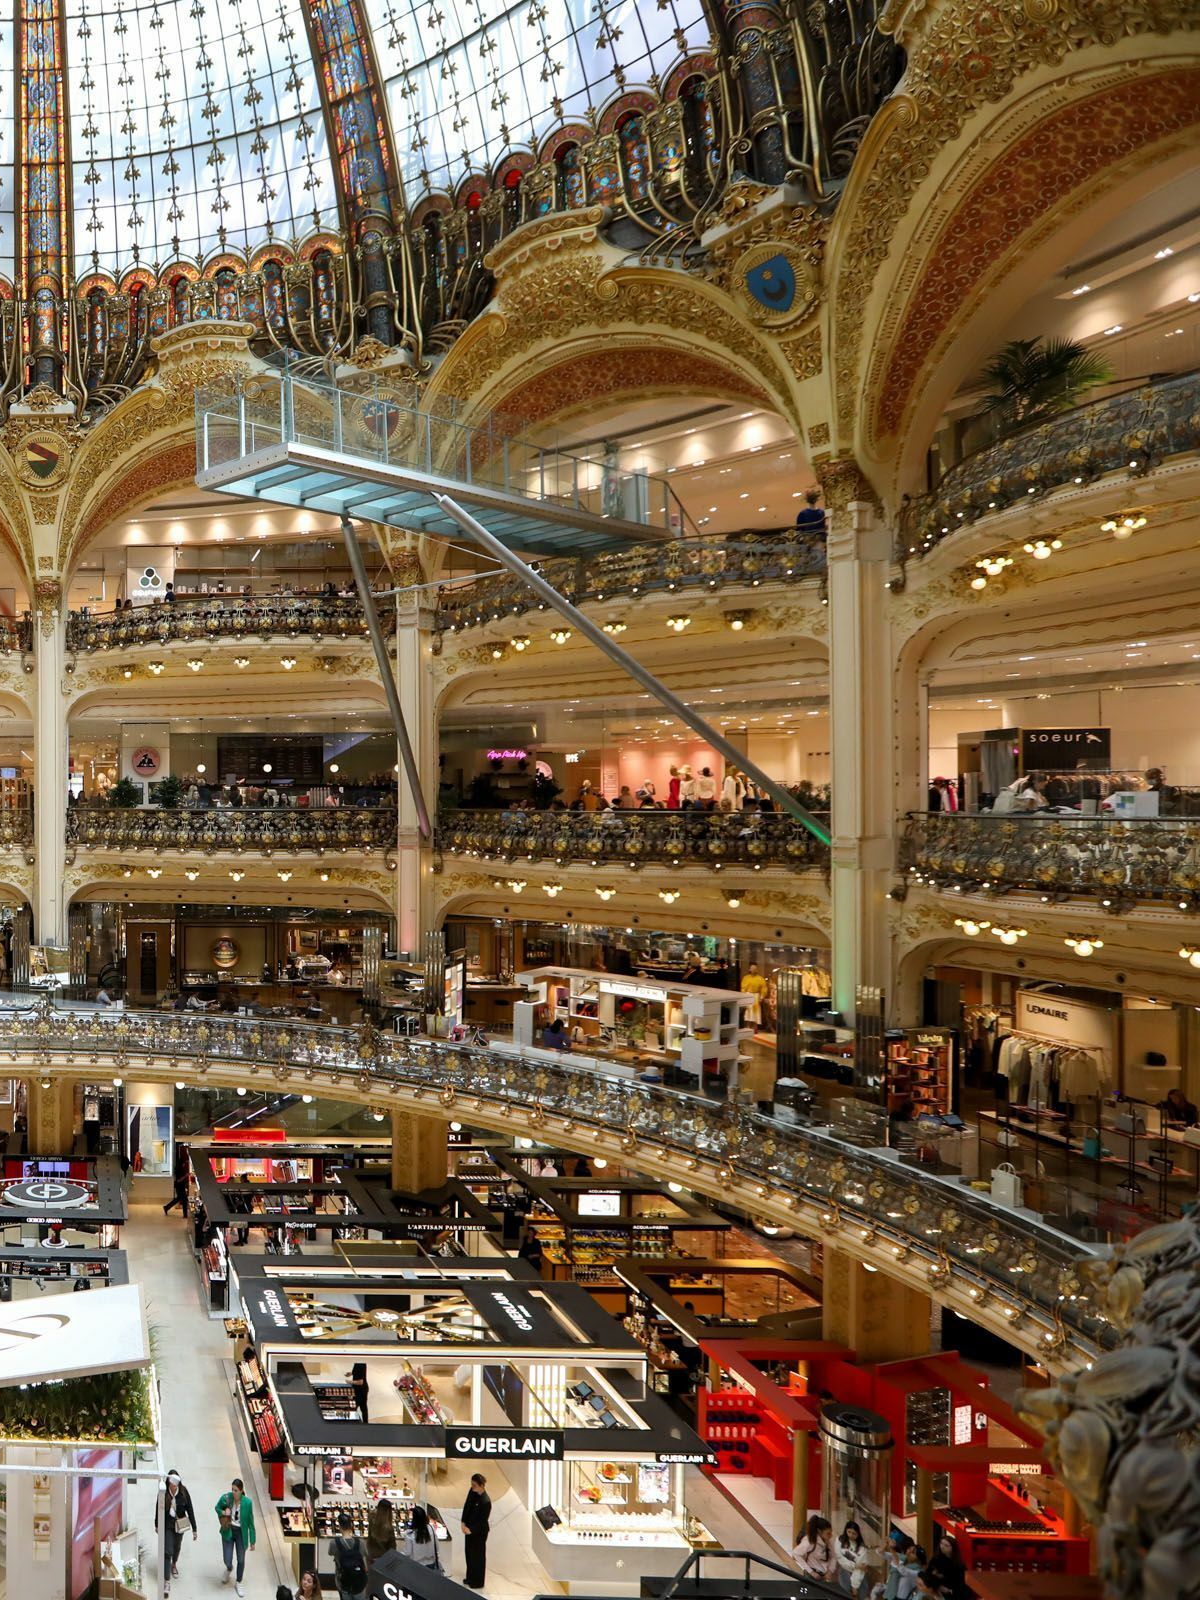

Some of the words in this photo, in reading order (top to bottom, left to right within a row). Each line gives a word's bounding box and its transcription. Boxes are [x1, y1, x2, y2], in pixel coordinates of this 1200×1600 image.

[1029, 732, 1082, 743] soeur
[1026, 1003, 1069, 1021] LEMAIRE
[262, 1289, 289, 1328] GUERLAIN
[490, 1292, 533, 1331] GUERLAIN
[298, 1446, 342, 1456] GUERLAIN
[455, 1437, 556, 1455] GUERLAIN
[659, 1454, 704, 1463] GUERLAIN
